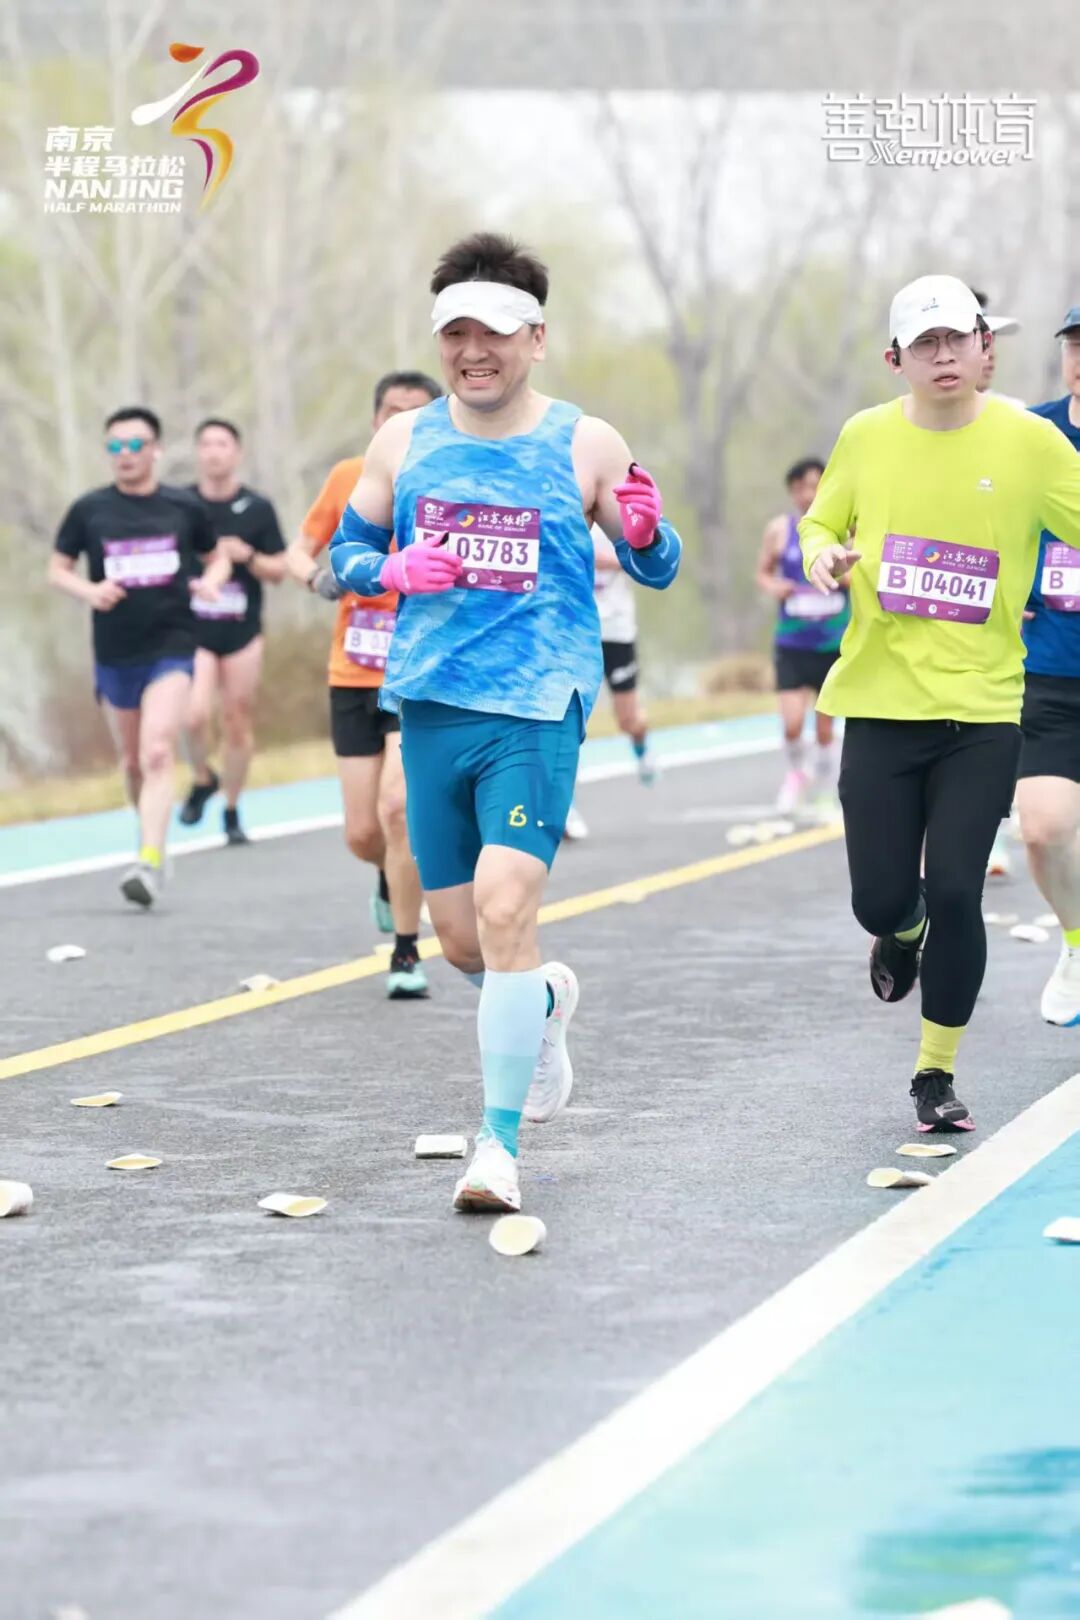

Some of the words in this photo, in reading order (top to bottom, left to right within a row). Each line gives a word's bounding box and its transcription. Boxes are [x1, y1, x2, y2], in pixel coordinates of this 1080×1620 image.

[456, 536, 529, 566] 03783
[887, 565, 907, 589] B
[921, 571, 987, 601] 04041
[1049, 570, 1064, 589] B
